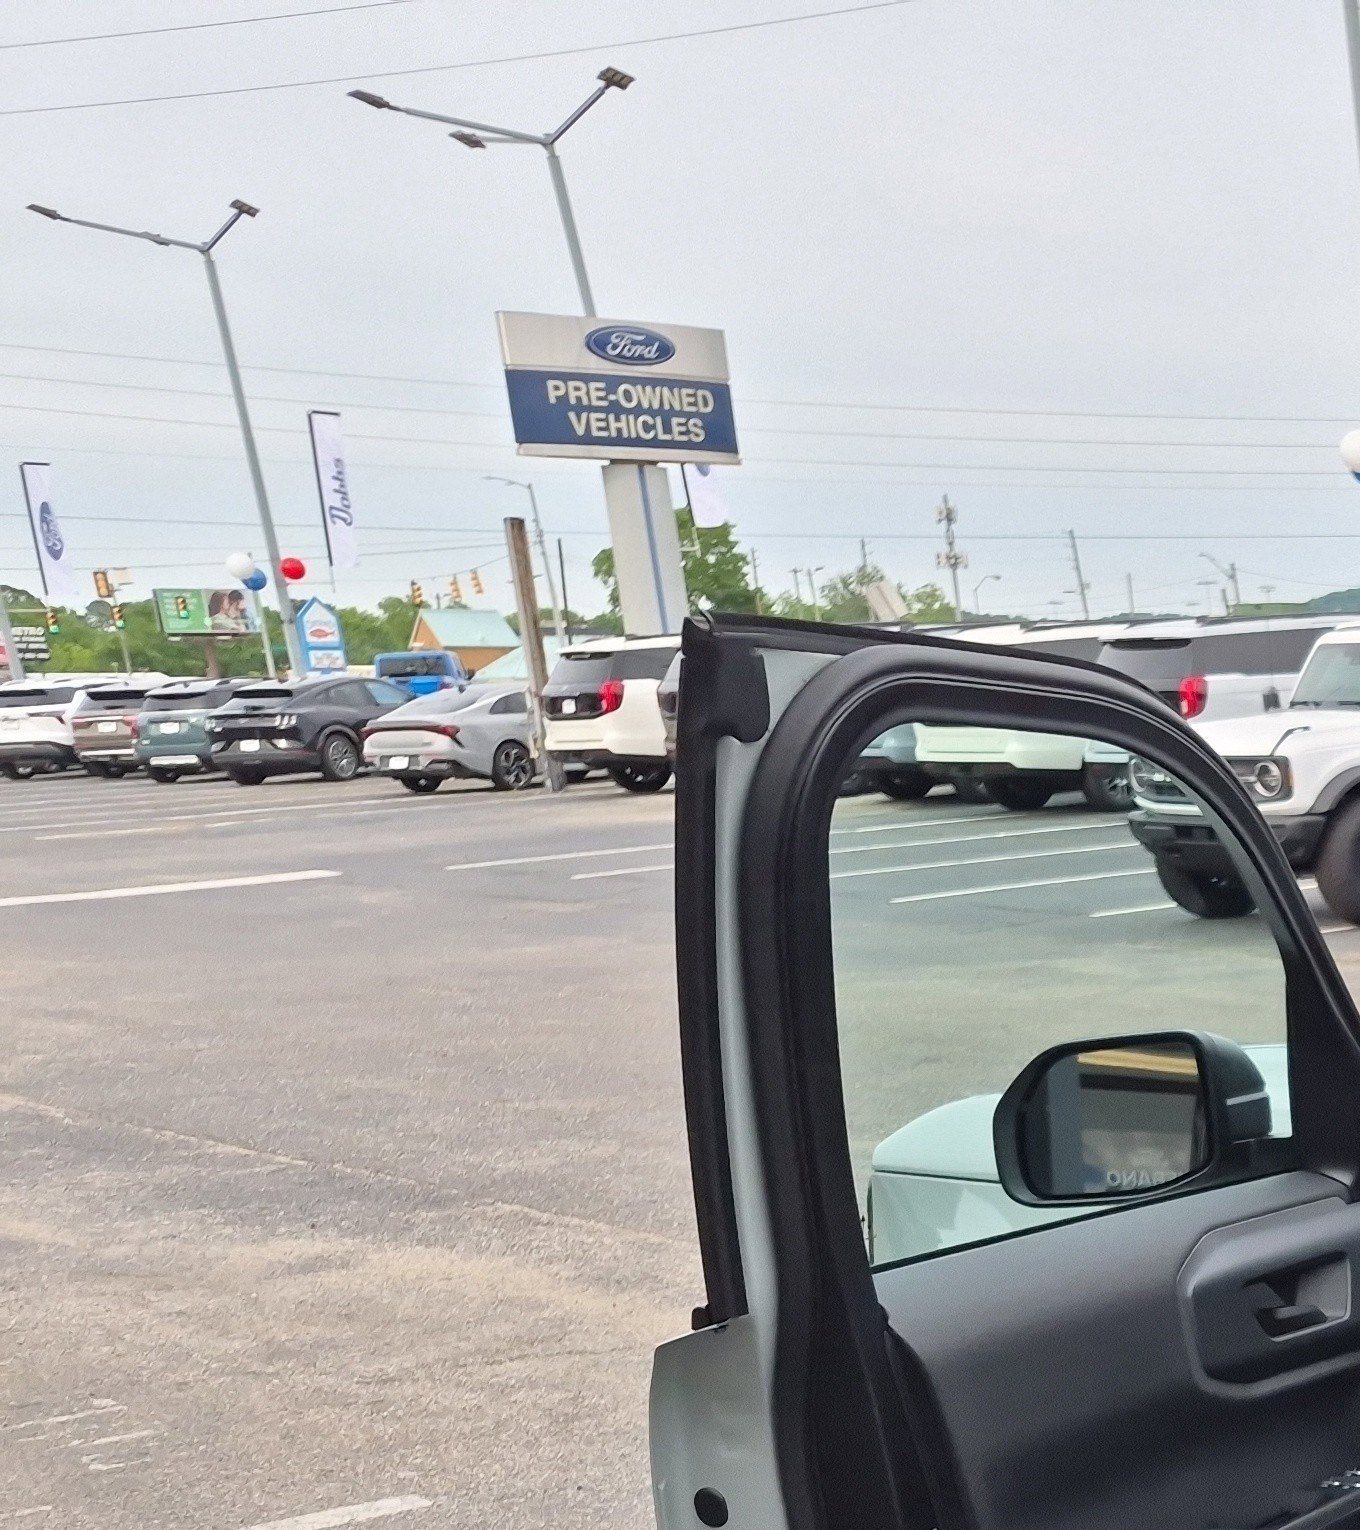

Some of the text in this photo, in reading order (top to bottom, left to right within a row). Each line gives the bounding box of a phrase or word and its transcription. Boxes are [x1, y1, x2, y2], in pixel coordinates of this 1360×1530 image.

[606, 331, 661, 359] Ford
[546, 379, 715, 414] PRE-OWNED
[567, 411, 706, 443] VEHICLES
[328, 457, 353, 527] Dobbs
